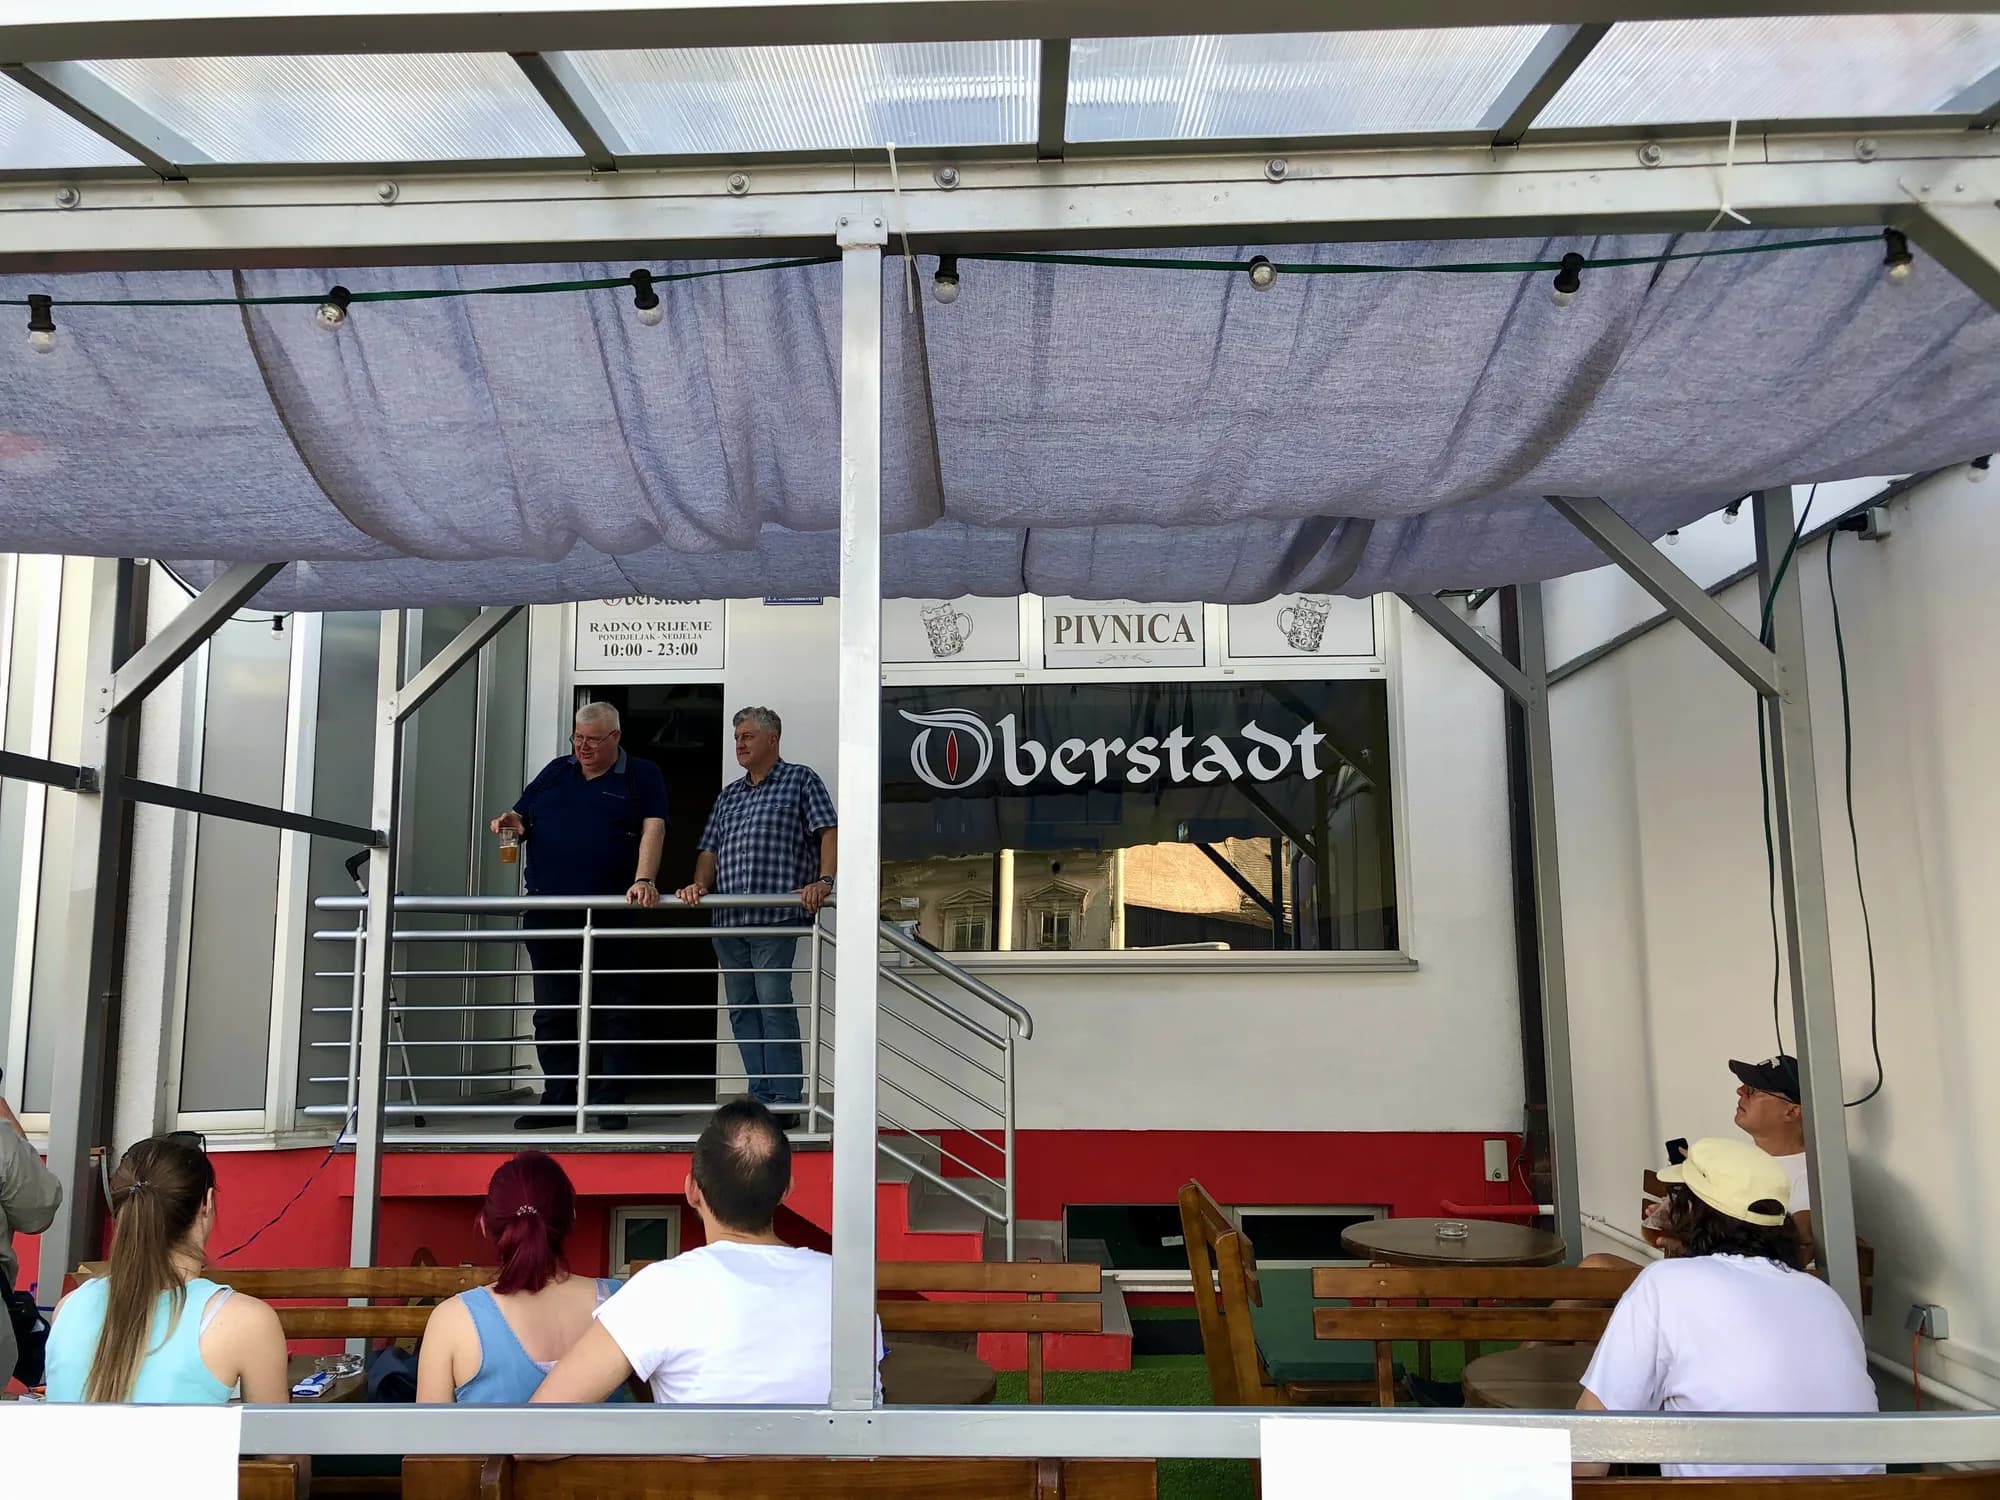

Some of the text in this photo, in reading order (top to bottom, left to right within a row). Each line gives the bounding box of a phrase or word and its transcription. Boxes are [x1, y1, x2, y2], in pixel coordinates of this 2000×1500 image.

[590, 621, 712, 632] RADNO VRIJEME
[1053, 613, 1195, 644] PIVNICA
[602, 643, 642, 657] 10:00
[657, 642, 698, 656] 23:00
[898, 708, 1327, 789] Oberstadt
